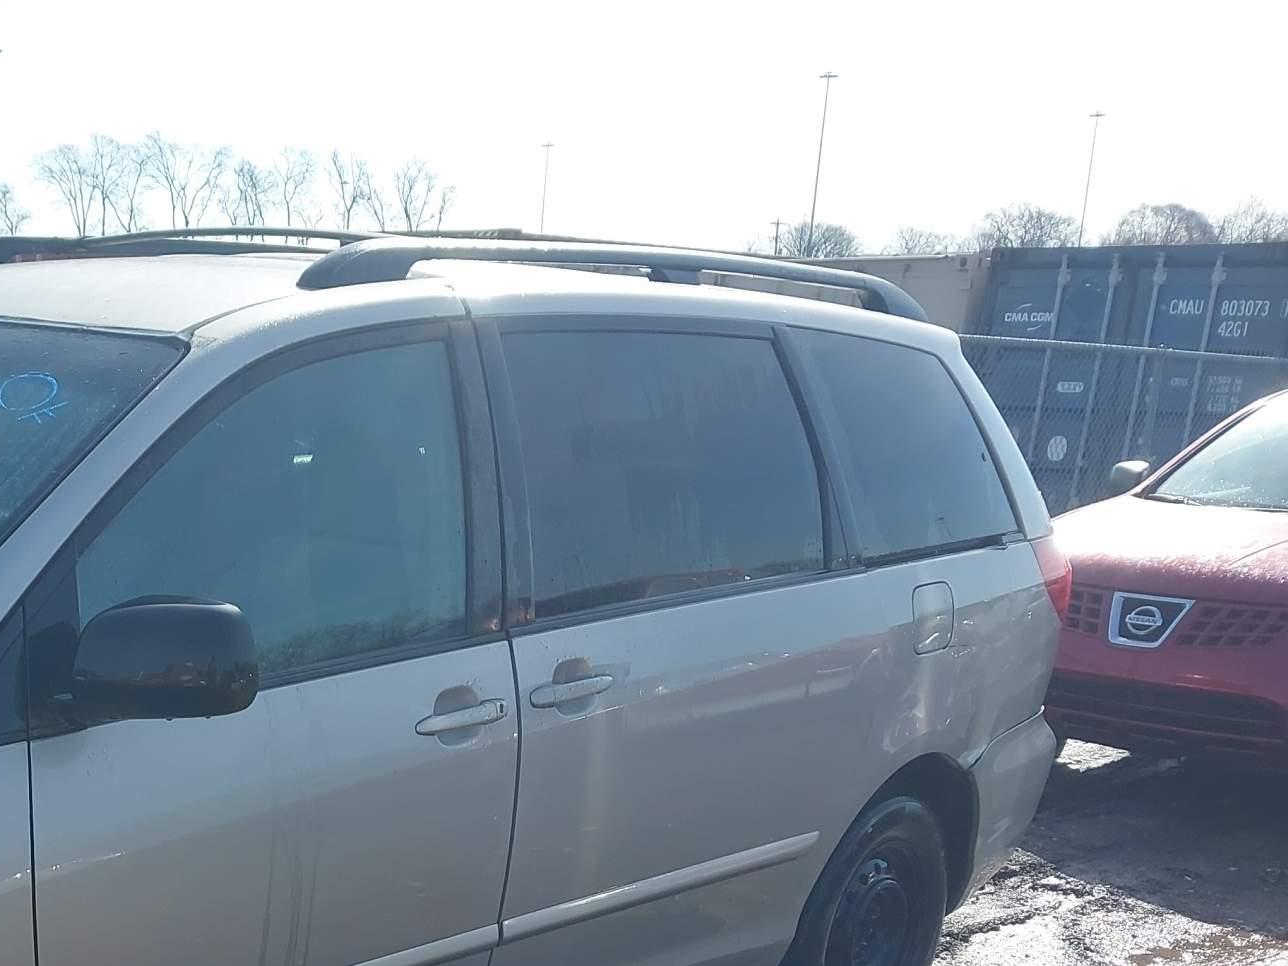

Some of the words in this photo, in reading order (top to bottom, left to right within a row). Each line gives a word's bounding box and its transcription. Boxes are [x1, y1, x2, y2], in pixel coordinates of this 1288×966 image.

[1169, 299, 1204, 315] CMAU
[1220, 300, 1270, 317] 803073
[1004, 311, 1029, 323] CMA
[1030, 311, 1055, 323] CGM
[1217, 321, 1249, 337] 42G1
